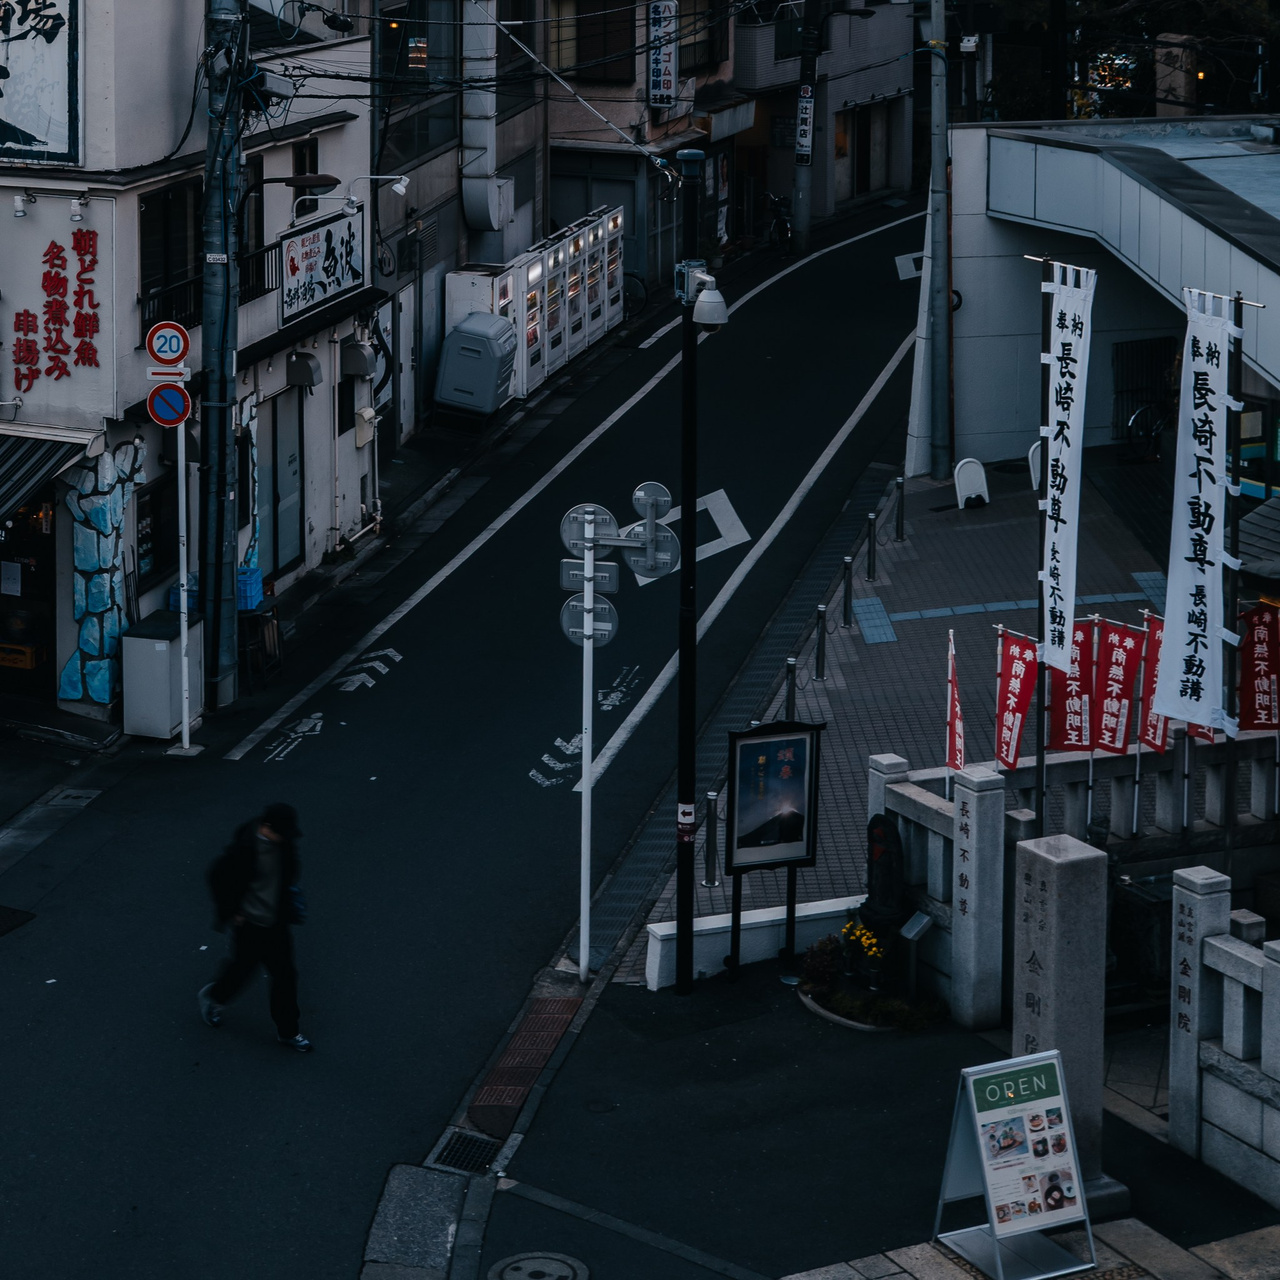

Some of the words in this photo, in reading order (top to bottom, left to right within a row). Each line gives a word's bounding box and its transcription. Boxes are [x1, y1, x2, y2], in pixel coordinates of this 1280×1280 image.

[71, 228, 99, 367] 朝どれ鮮魚
[313, 221, 362, 294] 魚波
[12, 309, 41, 393] 串揚げ
[41, 240, 70, 380] 名物煮込み
[157, 335, 180, 354] 20
[1055, 309, 1083, 340] 奉納
[1191, 335, 1220, 370] 奉納
[1047, 342, 1077, 533] 長崎不動尊
[1186, 371, 1216, 574] 長崎不動尊
[1049, 542, 1067, 649] 長崎不動講
[1180, 585, 1207, 702] 長崎不動講
[959, 801, 970, 916] 長崎不動尊
[1177, 956, 1192, 1034] 金剛院
[986, 1074, 1046, 1102] OPEN
